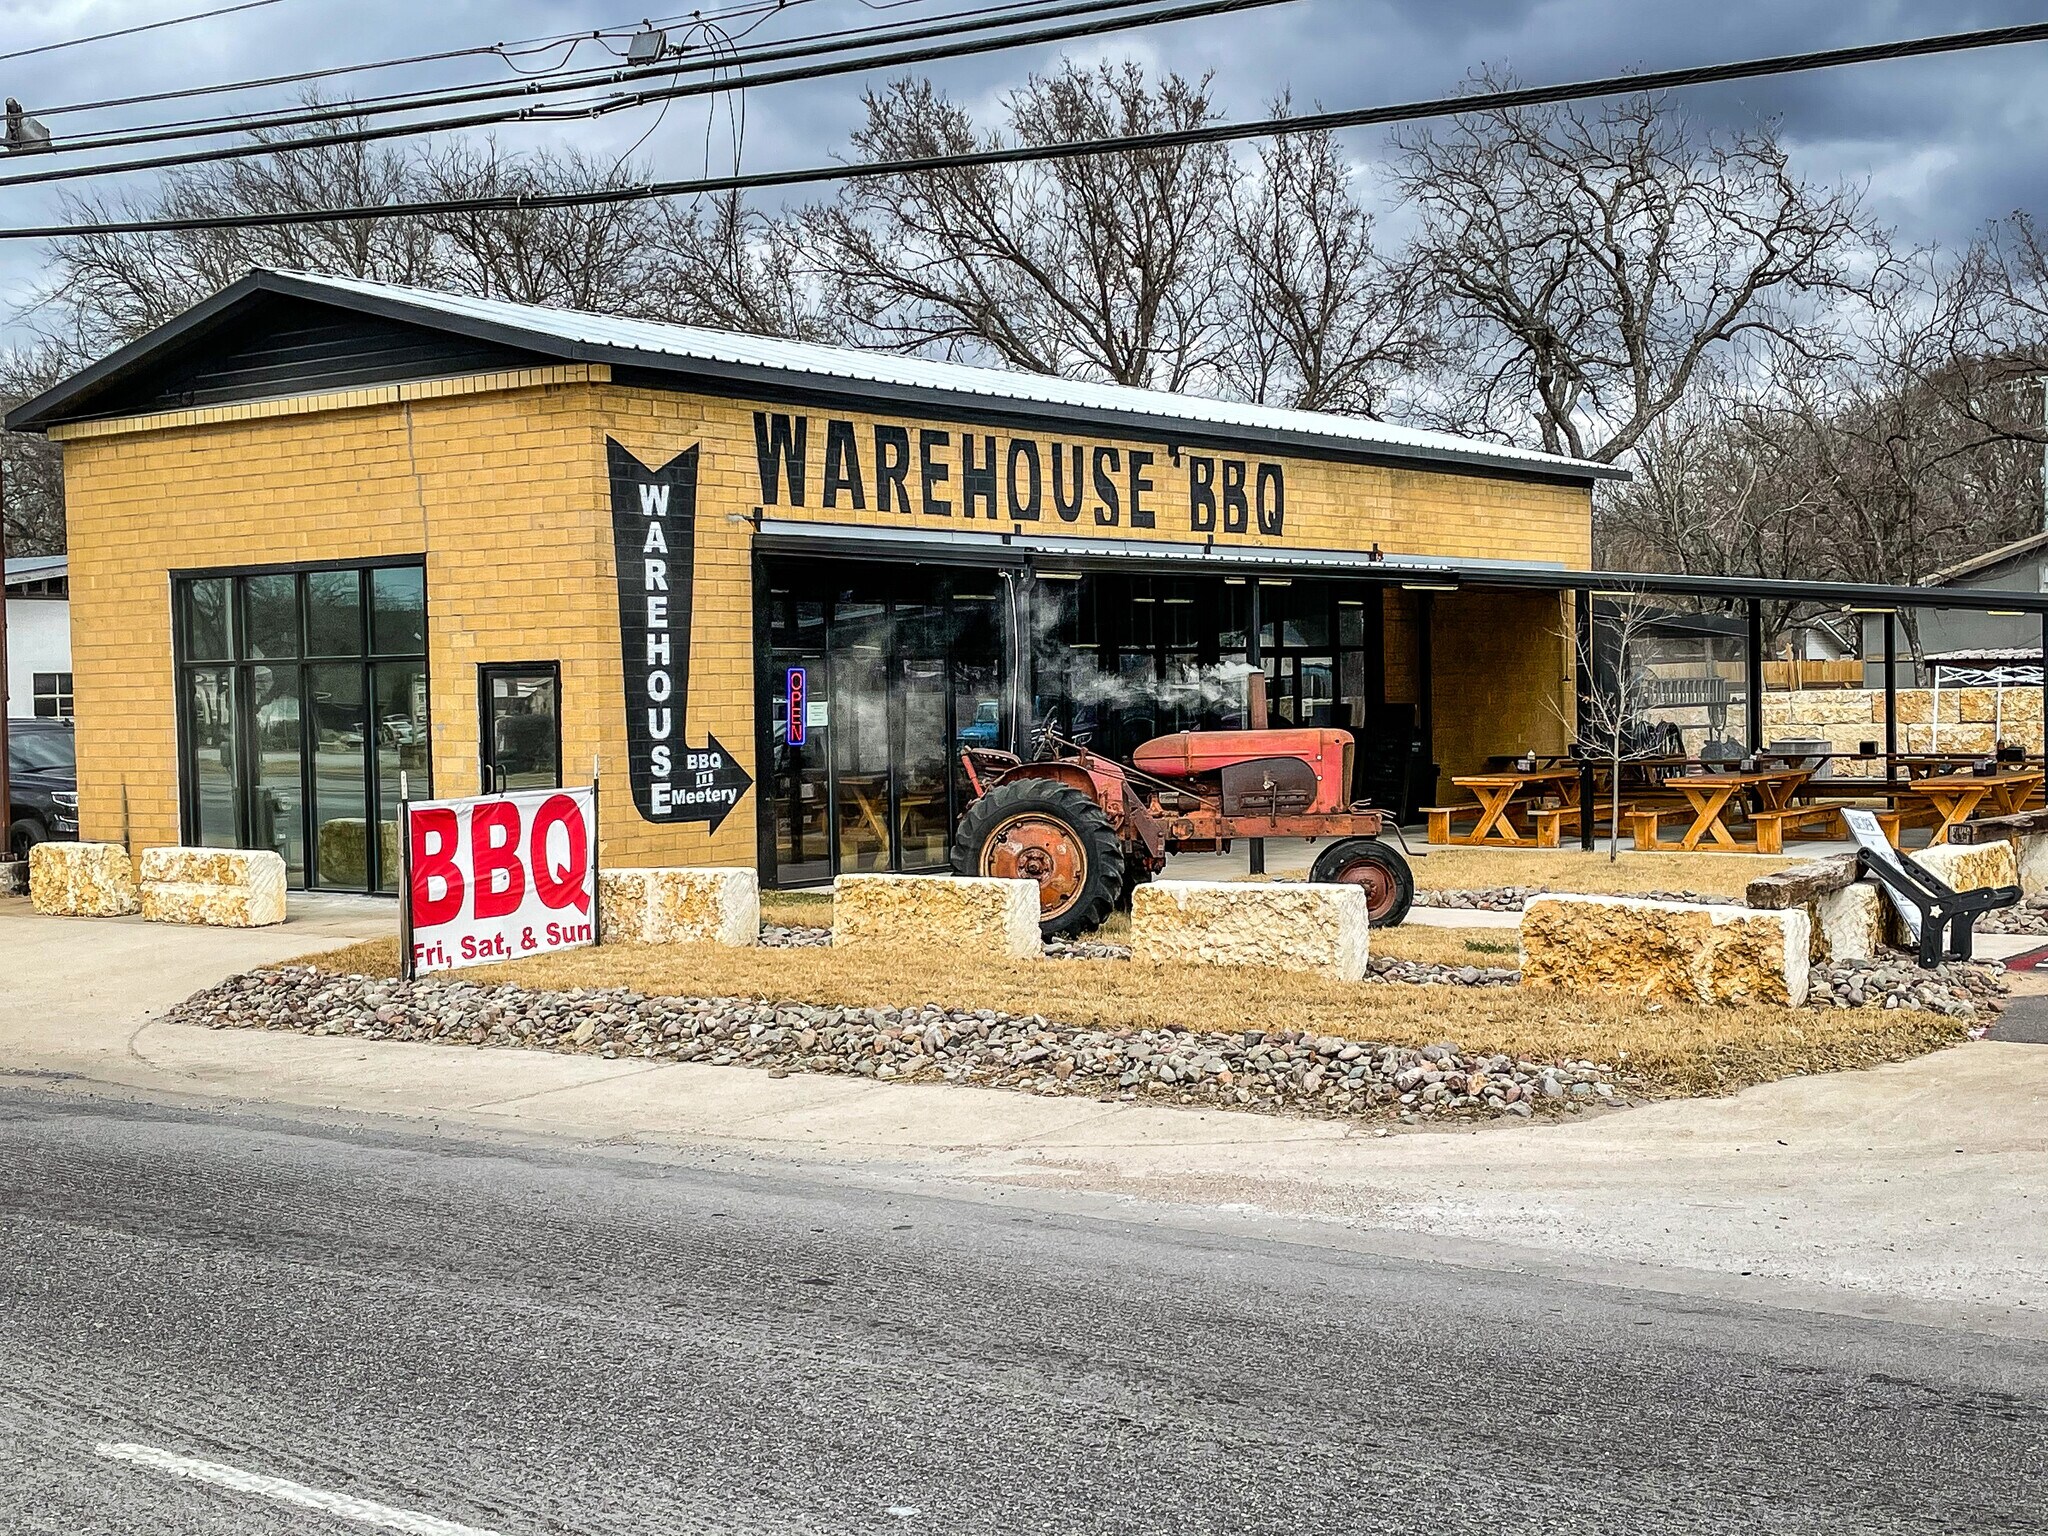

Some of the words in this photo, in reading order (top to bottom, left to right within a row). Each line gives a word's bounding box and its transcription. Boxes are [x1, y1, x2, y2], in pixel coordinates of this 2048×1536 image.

[753, 411, 1155, 528] WAREHOUSE
[1190, 456, 1284, 536] BBQ
[638, 484, 672, 815] WAREHOUSE
[791, 673, 802, 741] OPEN
[687, 752, 722, 769] BBQ
[671, 788, 737, 805] Meetery
[411, 794, 591, 929] BBQ
[414, 940, 452, 968] Fri,
[461, 932, 512, 959] Sat,
[520, 927, 538, 950] &
[546, 922, 592, 946] Sun
